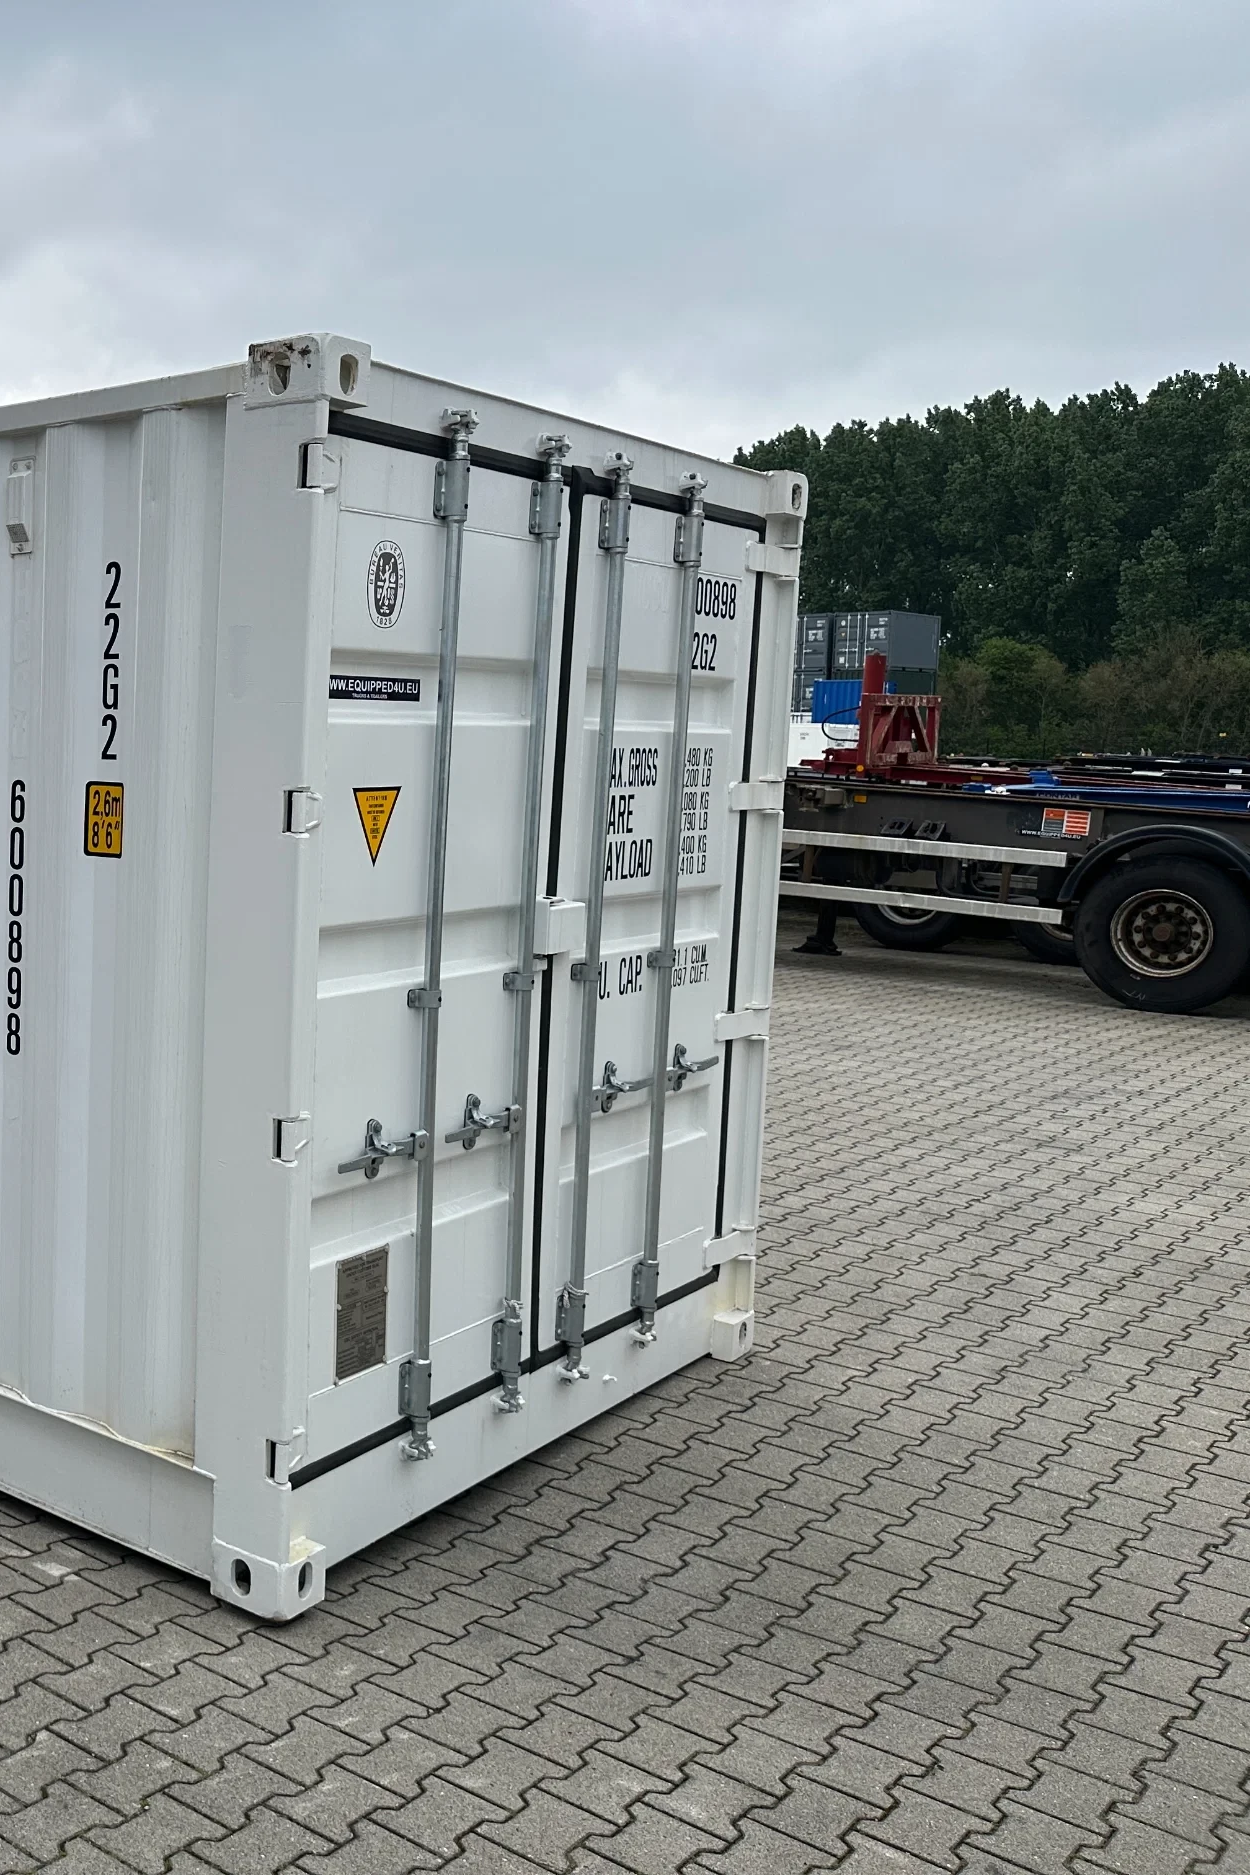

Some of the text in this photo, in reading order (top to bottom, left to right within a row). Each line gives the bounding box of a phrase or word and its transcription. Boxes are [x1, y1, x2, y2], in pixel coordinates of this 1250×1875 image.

[695, 576, 737, 620] 00898
[101, 561, 121, 760] 22G2
[691, 631, 717, 671] 2G2
[330, 678, 419, 694] WW.EQUIPPED4U.EU
[610, 748, 658, 788] AX.GROSS
[703, 747, 714, 767] KG
[701, 768, 711, 787] LB
[92, 789, 120, 820] 2,6m
[607, 794, 635, 835] ARE
[699, 791, 710, 810] KG
[698, 811, 708, 831] LB
[604, 839, 652, 881] AYLOAD
[697, 834, 707, 853] KG
[696, 854, 707, 874] LB
[6, 779, 26, 1056] 600898
[598, 954, 643, 1000] U. CAP.
